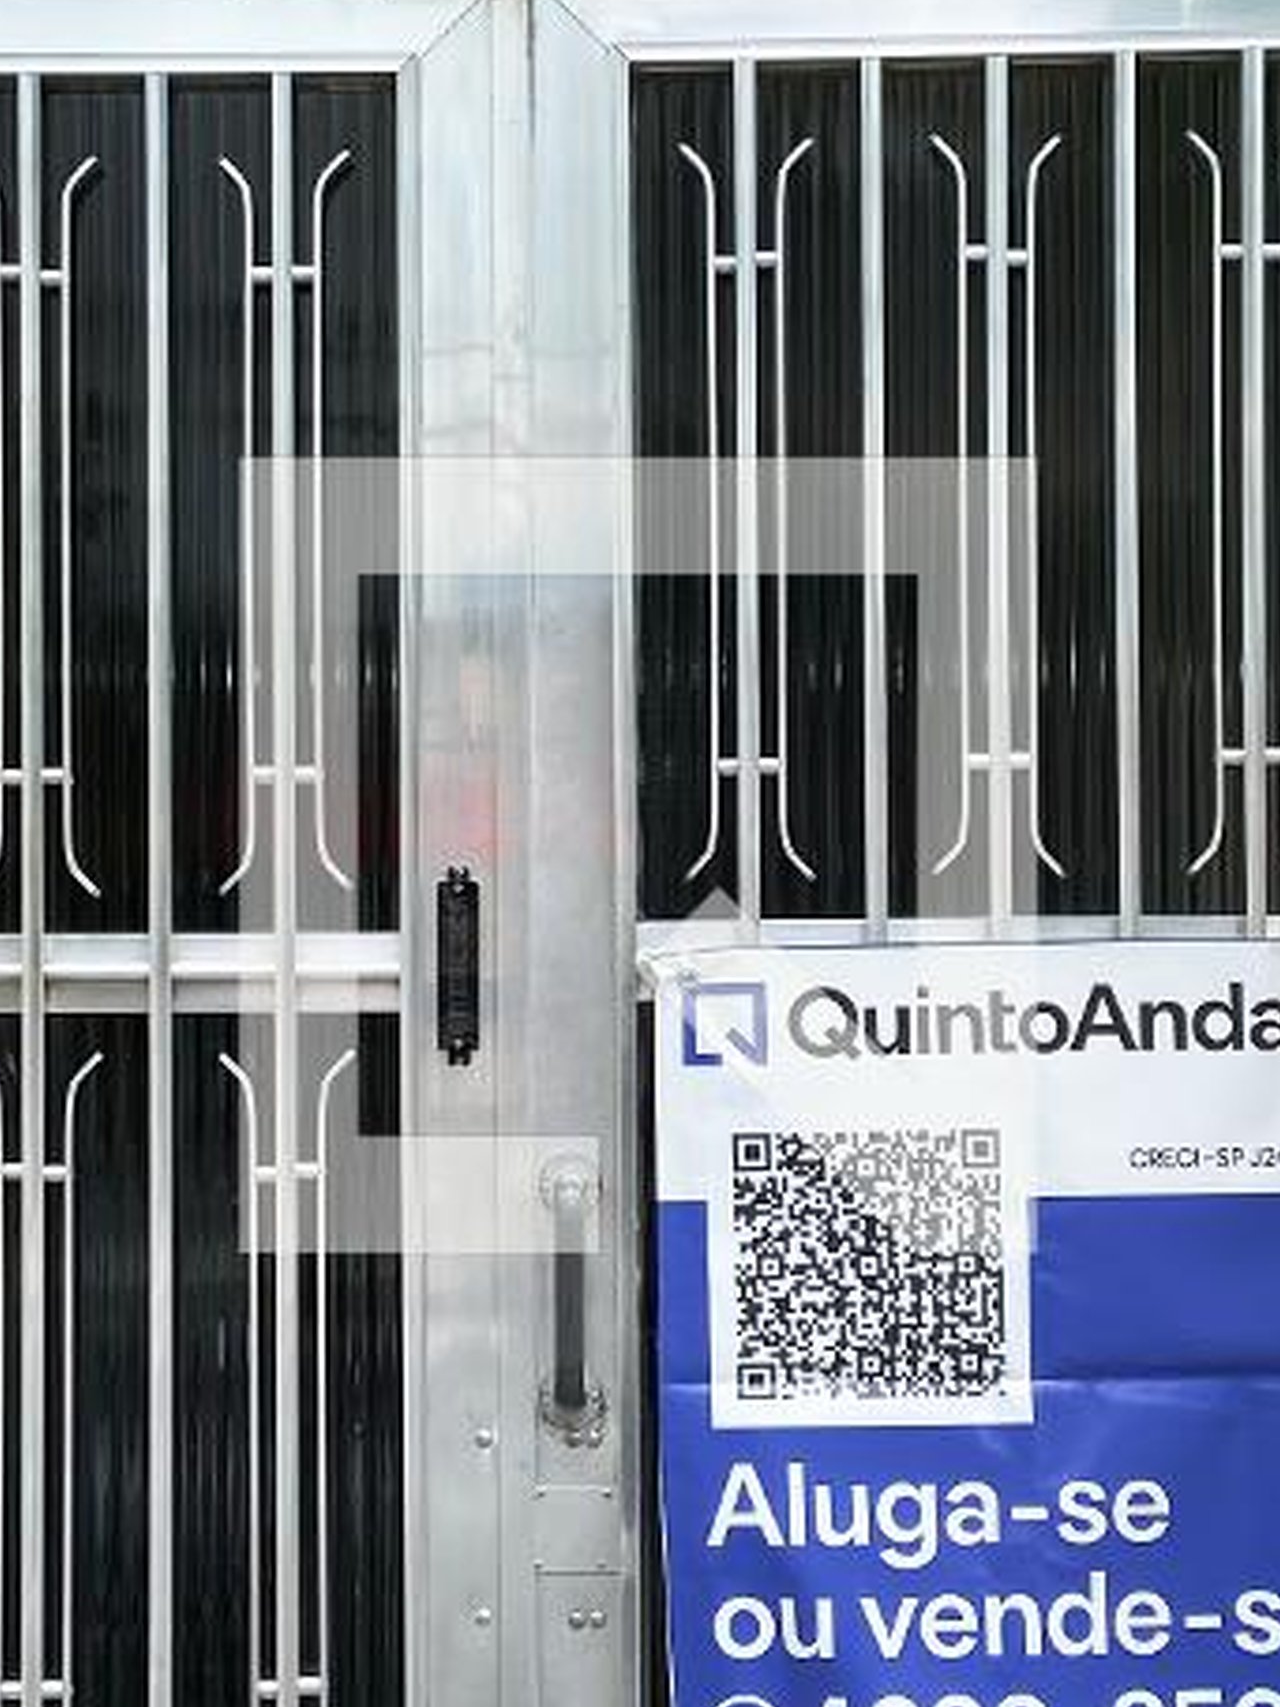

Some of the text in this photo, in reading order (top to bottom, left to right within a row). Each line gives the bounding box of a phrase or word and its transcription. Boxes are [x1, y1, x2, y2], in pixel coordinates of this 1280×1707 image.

[1129, 1146, 1245, 1169] CRECI-SP
[707, 1462, 1172, 1571] Aluga-se
[712, 1594, 835, 1662] ou
